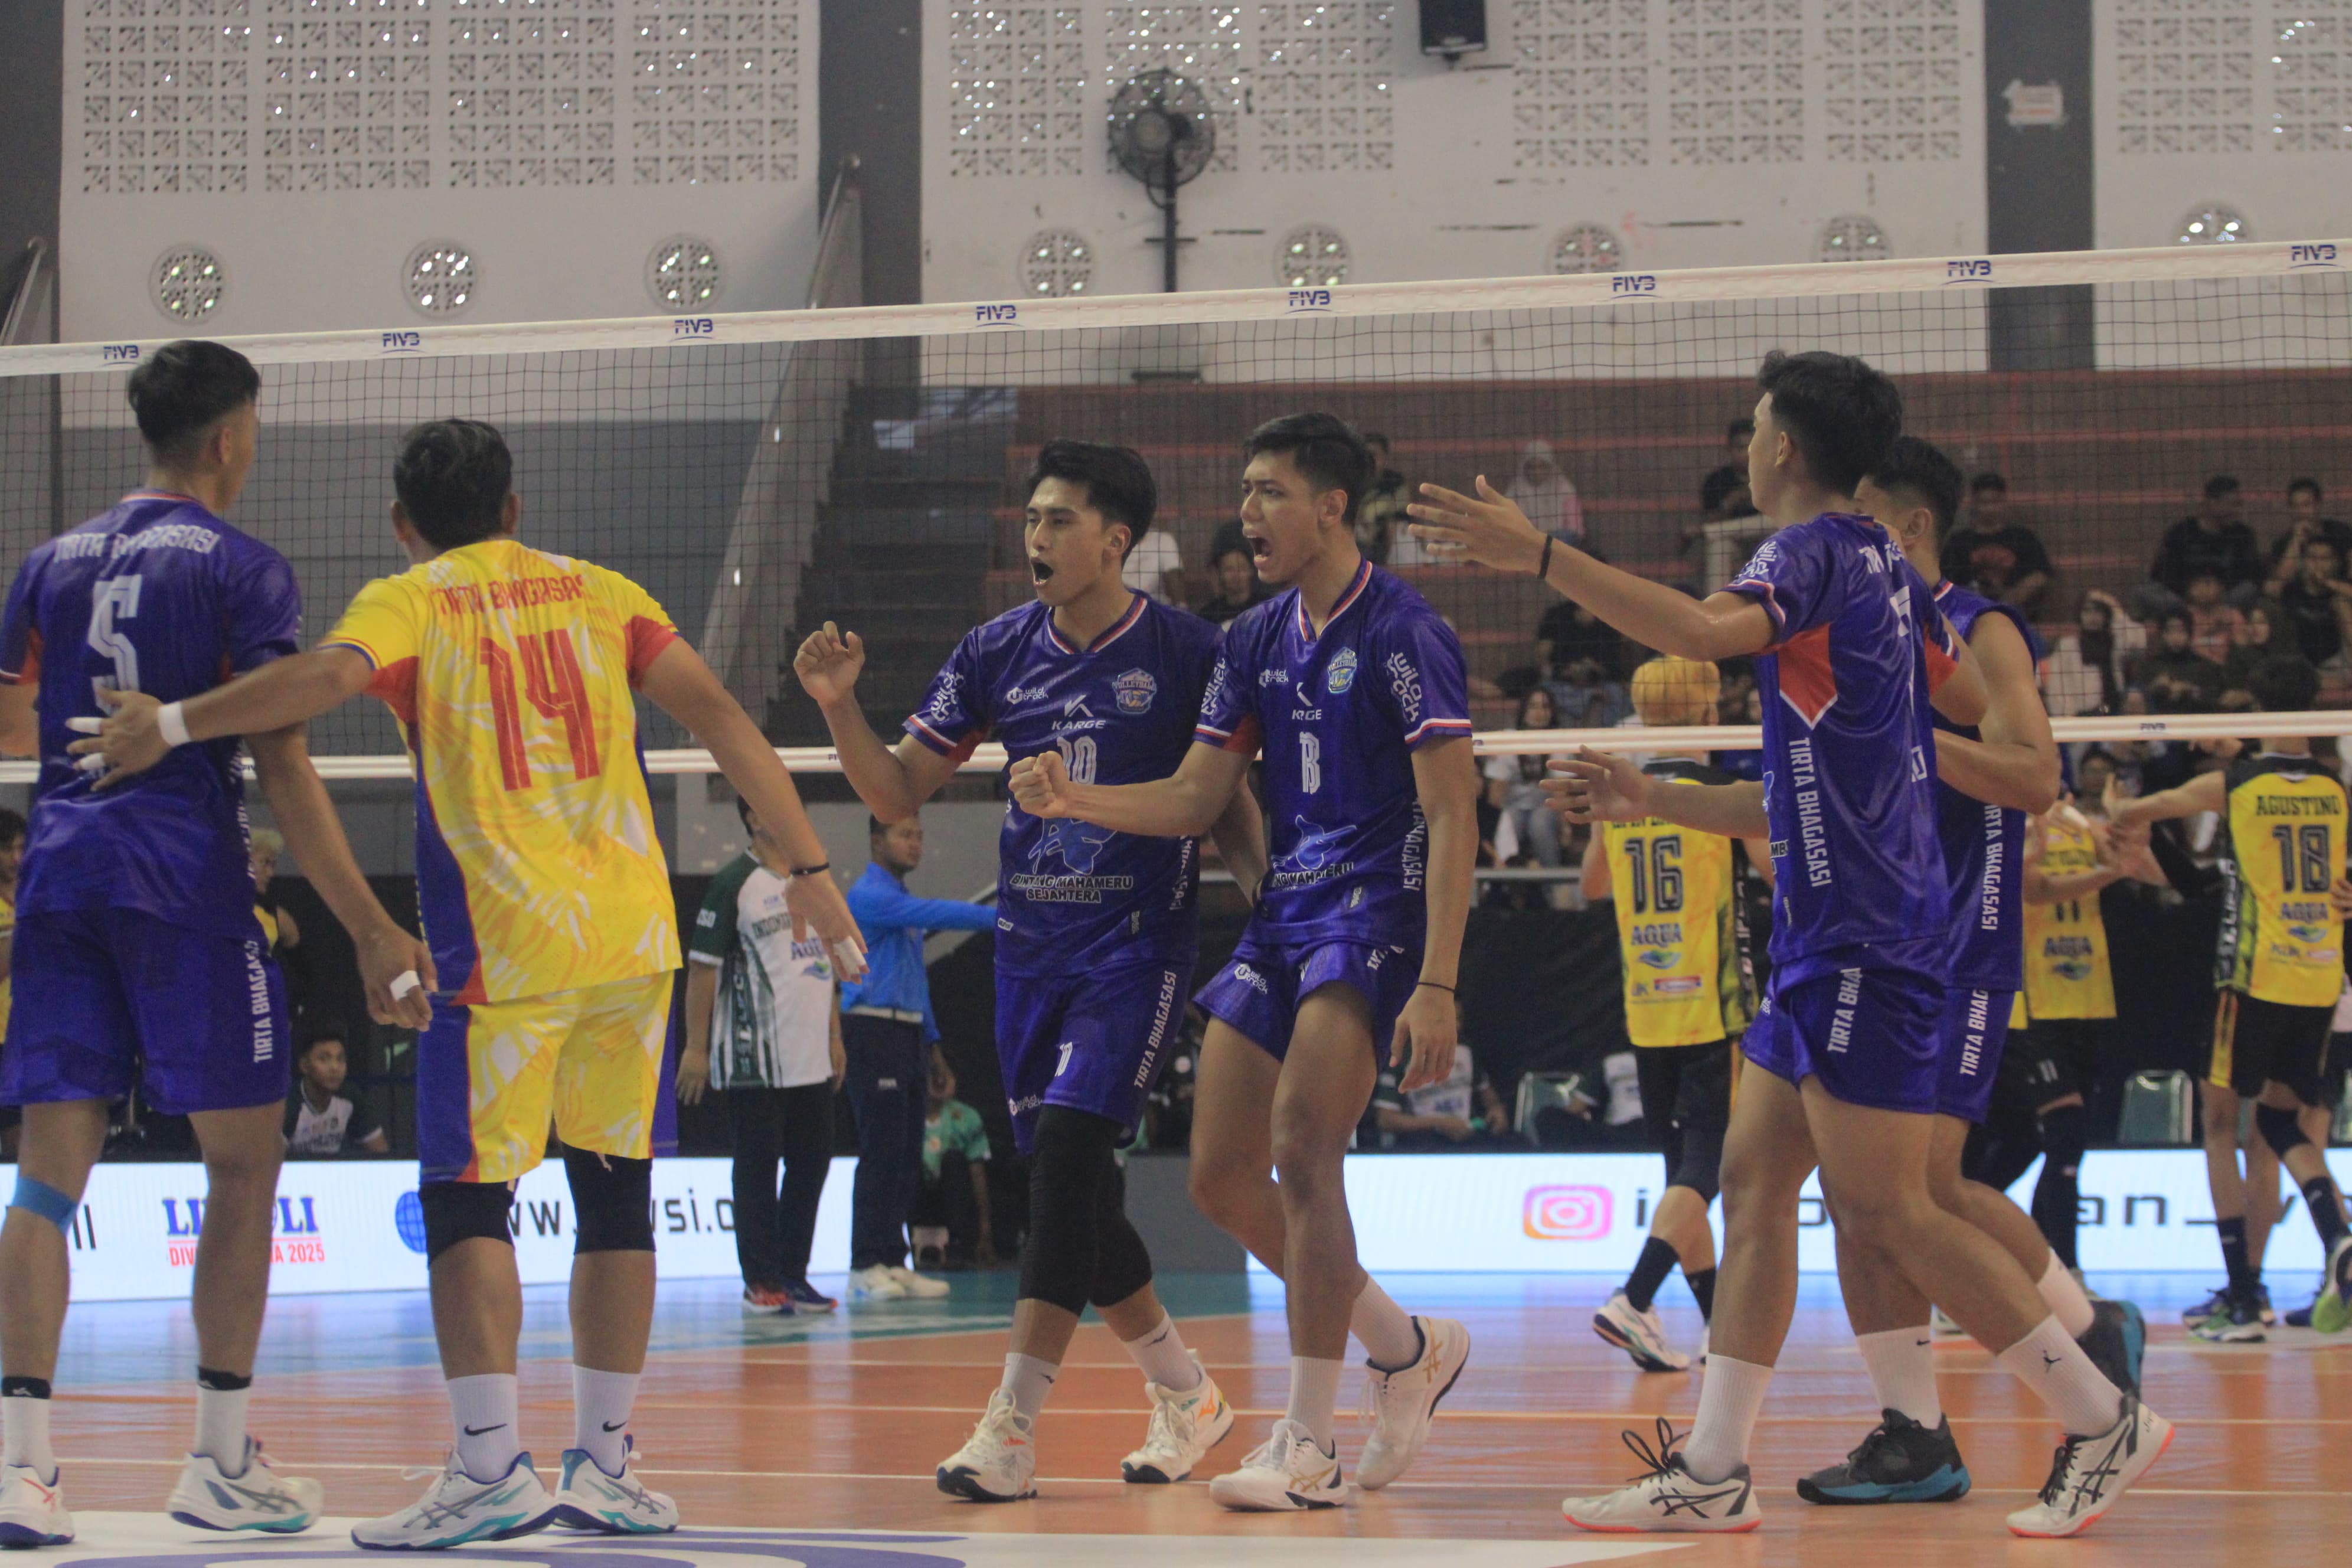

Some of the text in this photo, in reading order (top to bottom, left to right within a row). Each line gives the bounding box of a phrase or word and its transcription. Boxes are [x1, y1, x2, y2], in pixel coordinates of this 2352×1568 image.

[2292, 244, 2336, 260] FIVB
[1947, 260, 1991, 277] FIVB
[1613, 276, 1655, 291] FIVB
[1289, 290, 1330, 306] FIVB
[976, 305, 1017, 321] FIVB
[675, 319, 713, 334] FIVB
[383, 332, 420, 347] FIVB
[103, 345, 139, 360] FIVB
[88, 574, 142, 716] 5
[1023, 692, 1048, 701] track
[1025, 687, 1044, 695] wild
[480, 628, 600, 791] 14
[1052, 720, 1106, 730] KARGE
[1789, 737, 1832, 887] TIRTA BHAGASASI
[2272, 824, 2330, 893] 18
[1624, 834, 1683, 914] 16
[1056, 876, 1133, 890] MAHAMERU
[1981, 842, 2003, 930] BHAGASASI
[1026, 888, 1101, 903] SEJAHTERA
[1631, 923, 1683, 948] AQUA
[1134, 971, 1177, 1089] TIRTA BHAGASASI
[1827, 1009, 1855, 1054] TIRTA
[254, 1017, 273, 1063] TIRTA
[1959, 1034, 1984, 1076] TIRTA
[288, 1243, 325, 1263] 2025
